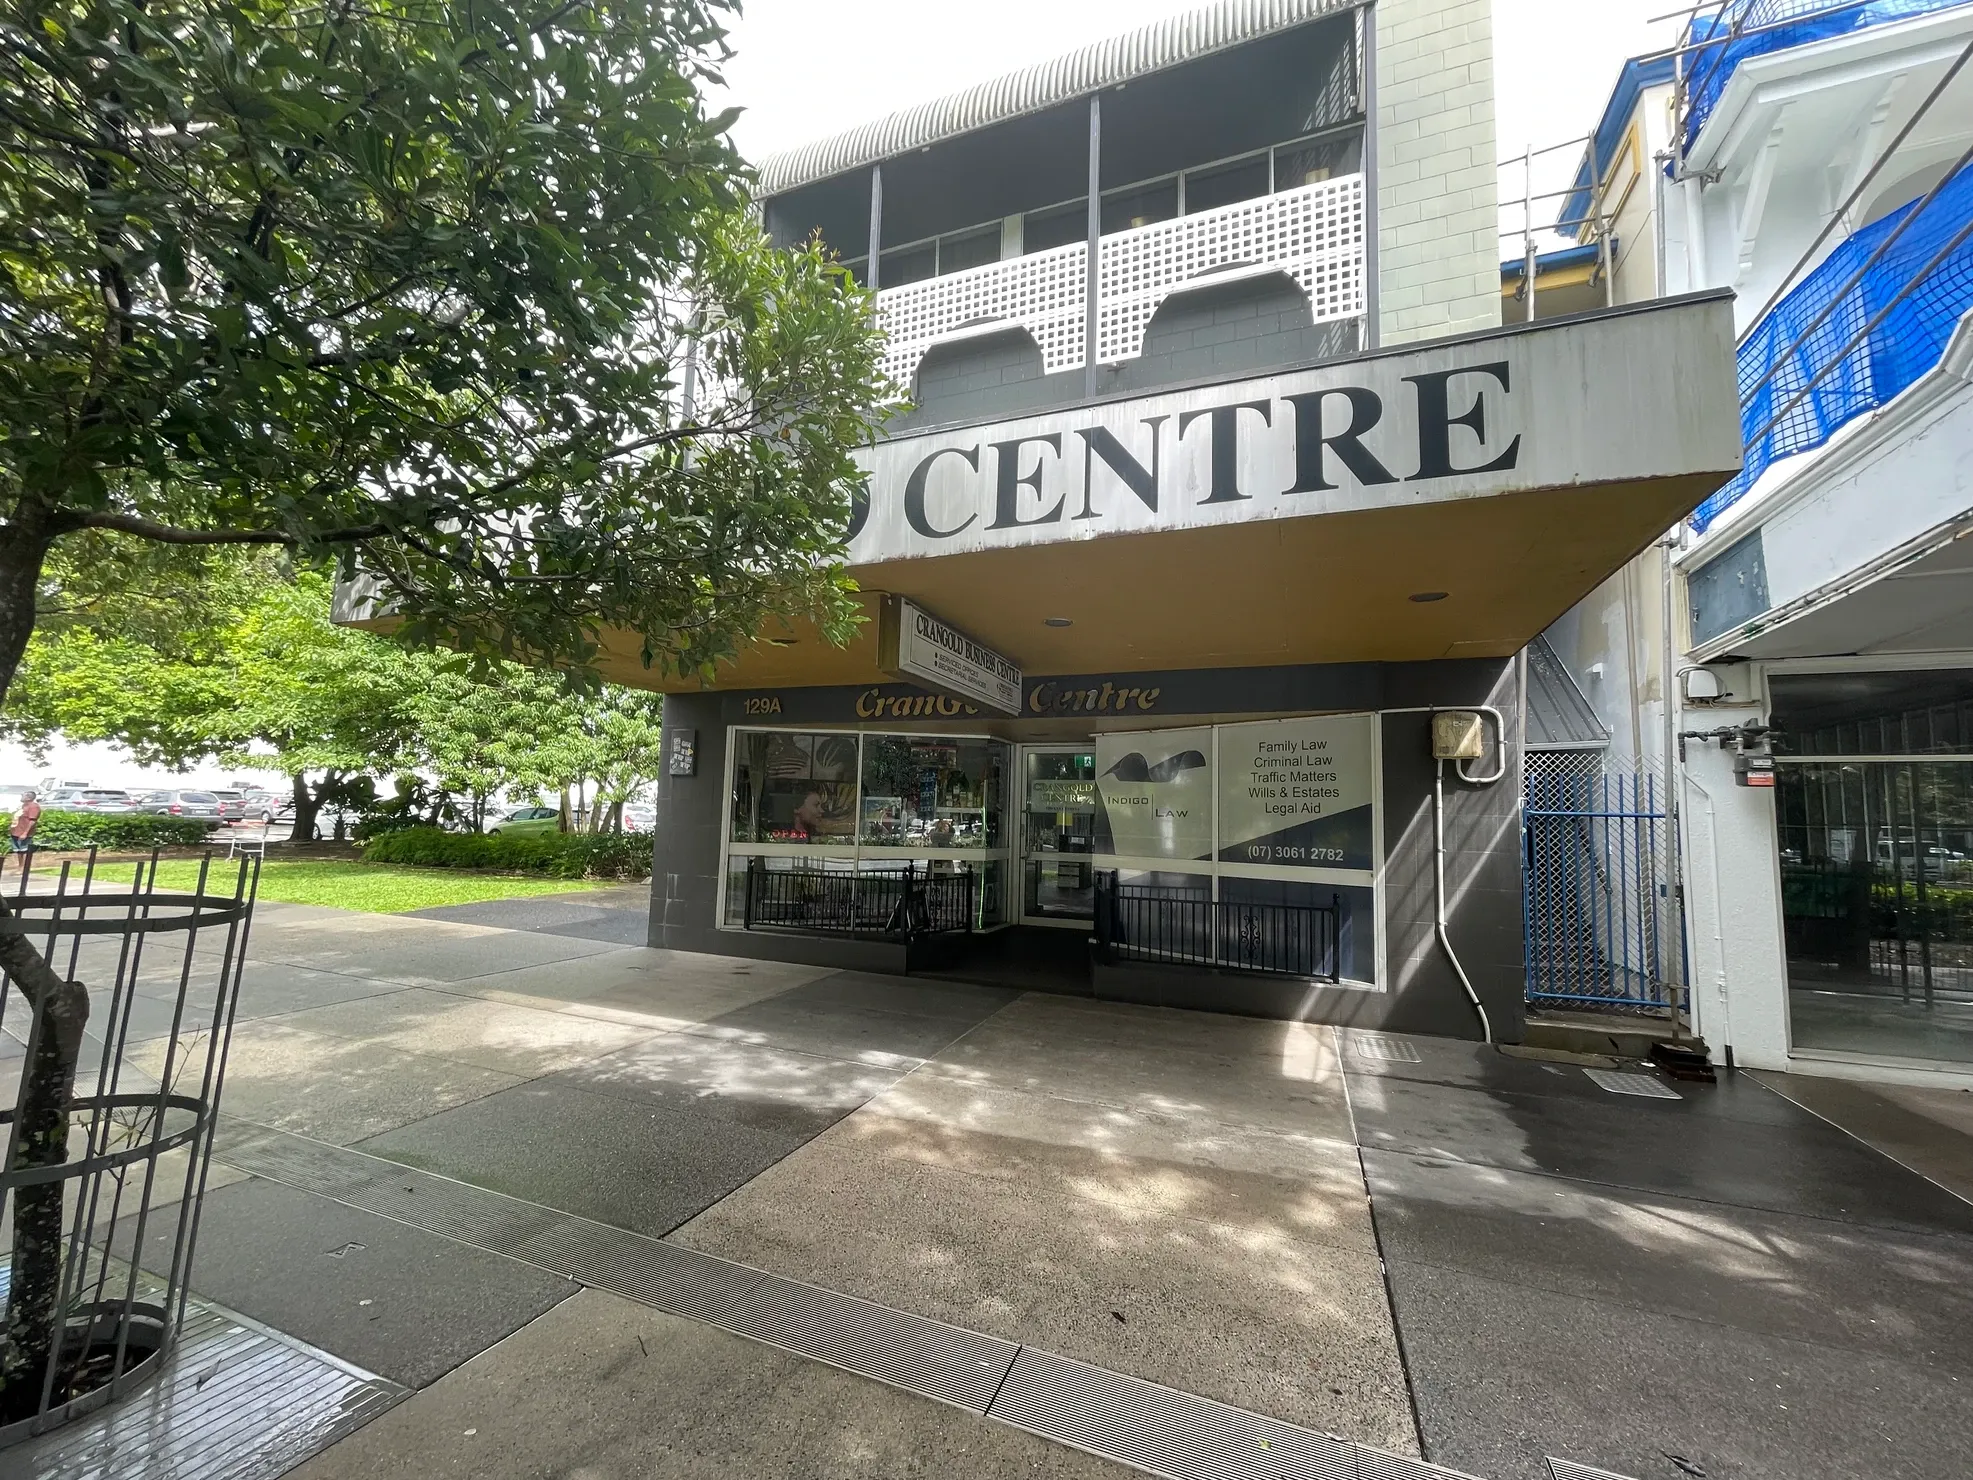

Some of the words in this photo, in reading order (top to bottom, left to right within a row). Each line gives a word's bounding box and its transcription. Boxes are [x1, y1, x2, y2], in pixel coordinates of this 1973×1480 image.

[903, 360, 1522, 539] CENTRE
[916, 613, 964, 655] CRANGOLD
[965, 640, 996, 673] BUSINESS
[996, 659, 1020, 685] CENTRE
[938, 653, 962, 671] SERVICED
[962, 664, 979, 678] OFFICES
[937, 662, 968, 681] SECRETARIAL
[968, 675, 987, 690] SERVICES
[744, 697, 782, 715] 129A
[1029, 682, 1160, 713] Centre
[1258, 741, 1298, 754] Family
[1301, 739, 1327, 751] Law
[1254, 755, 1302, 768] Criminal
[1306, 755, 1333, 767] Law
[1250, 771, 1286, 784] Traffic
[1290, 771, 1337, 783] Matters
[1248, 787, 1276, 799] Wills
[1279, 787, 1289, 798] &
[1292, 786, 1340, 799] Estates
[1265, 802, 1298, 817] Legal
[1300, 802, 1321, 815] Aid
[771, 829, 808, 839] OPEN
[1248, 845, 1272, 860] (07)
[1275, 846, 1306, 860] 3061
[1310, 847, 1344, 862] 2782
